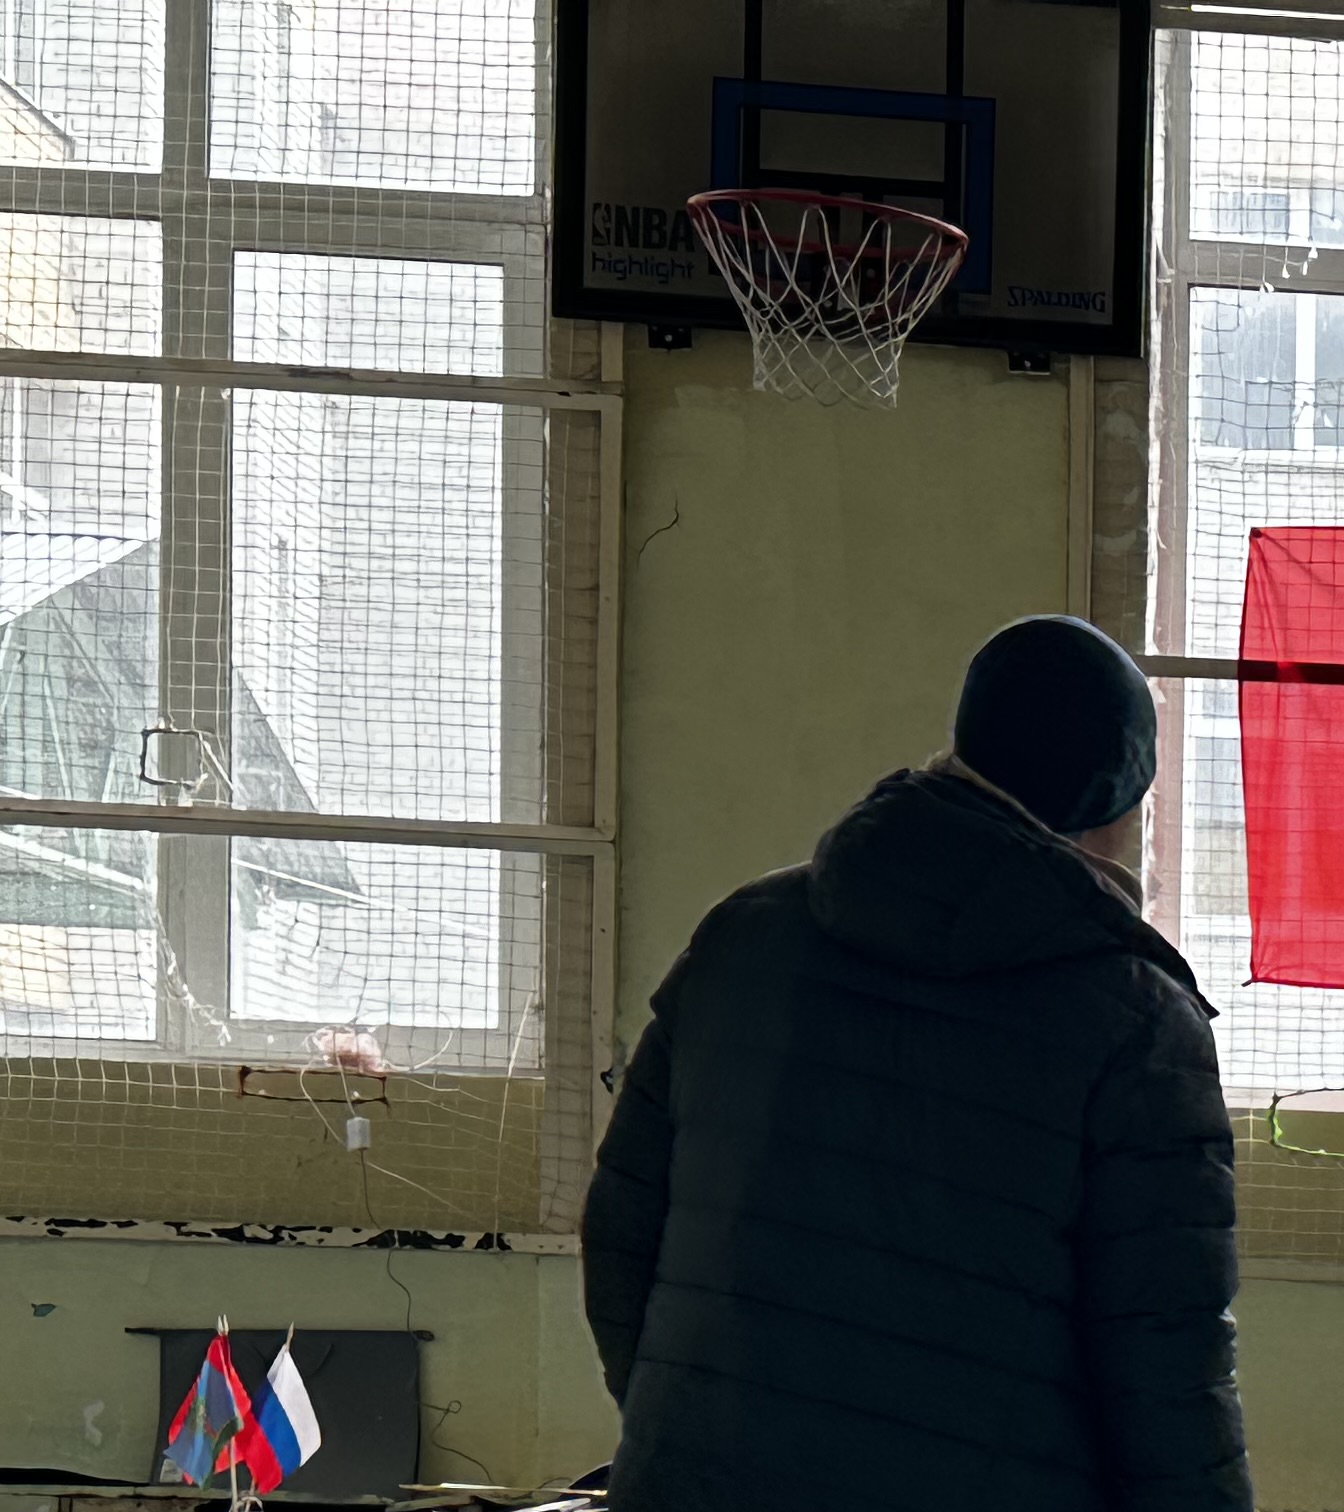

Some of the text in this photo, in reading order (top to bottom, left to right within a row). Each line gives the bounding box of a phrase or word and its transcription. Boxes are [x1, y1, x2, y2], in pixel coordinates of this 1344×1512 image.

[614, 203, 696, 252] NBA
[591, 251, 695, 285] highlight
[1007, 285, 1106, 313] SPALDING
